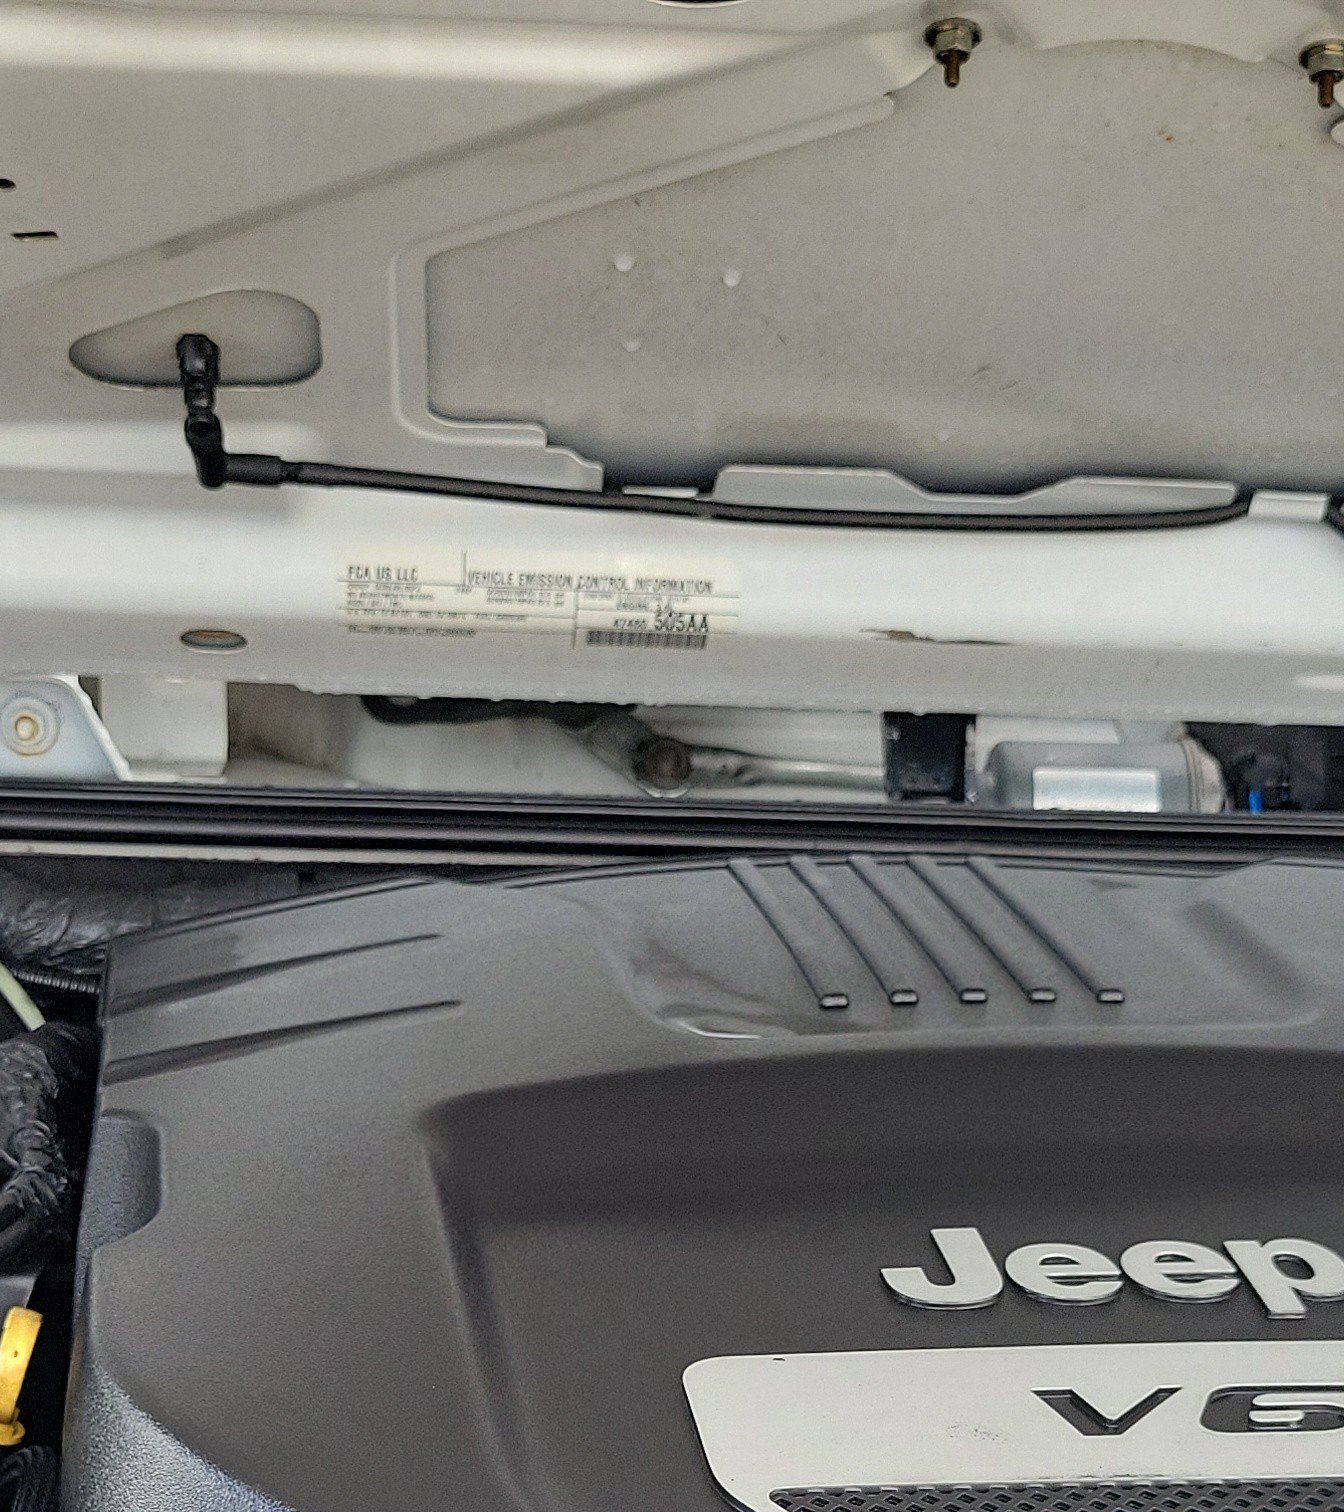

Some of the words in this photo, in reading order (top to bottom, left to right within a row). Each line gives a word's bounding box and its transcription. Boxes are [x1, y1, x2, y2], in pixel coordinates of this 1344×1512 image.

[467, 569, 514, 587] VEHICLE
[518, 571, 573, 590] EMISSION
[577, 574, 630, 592] CONTROL
